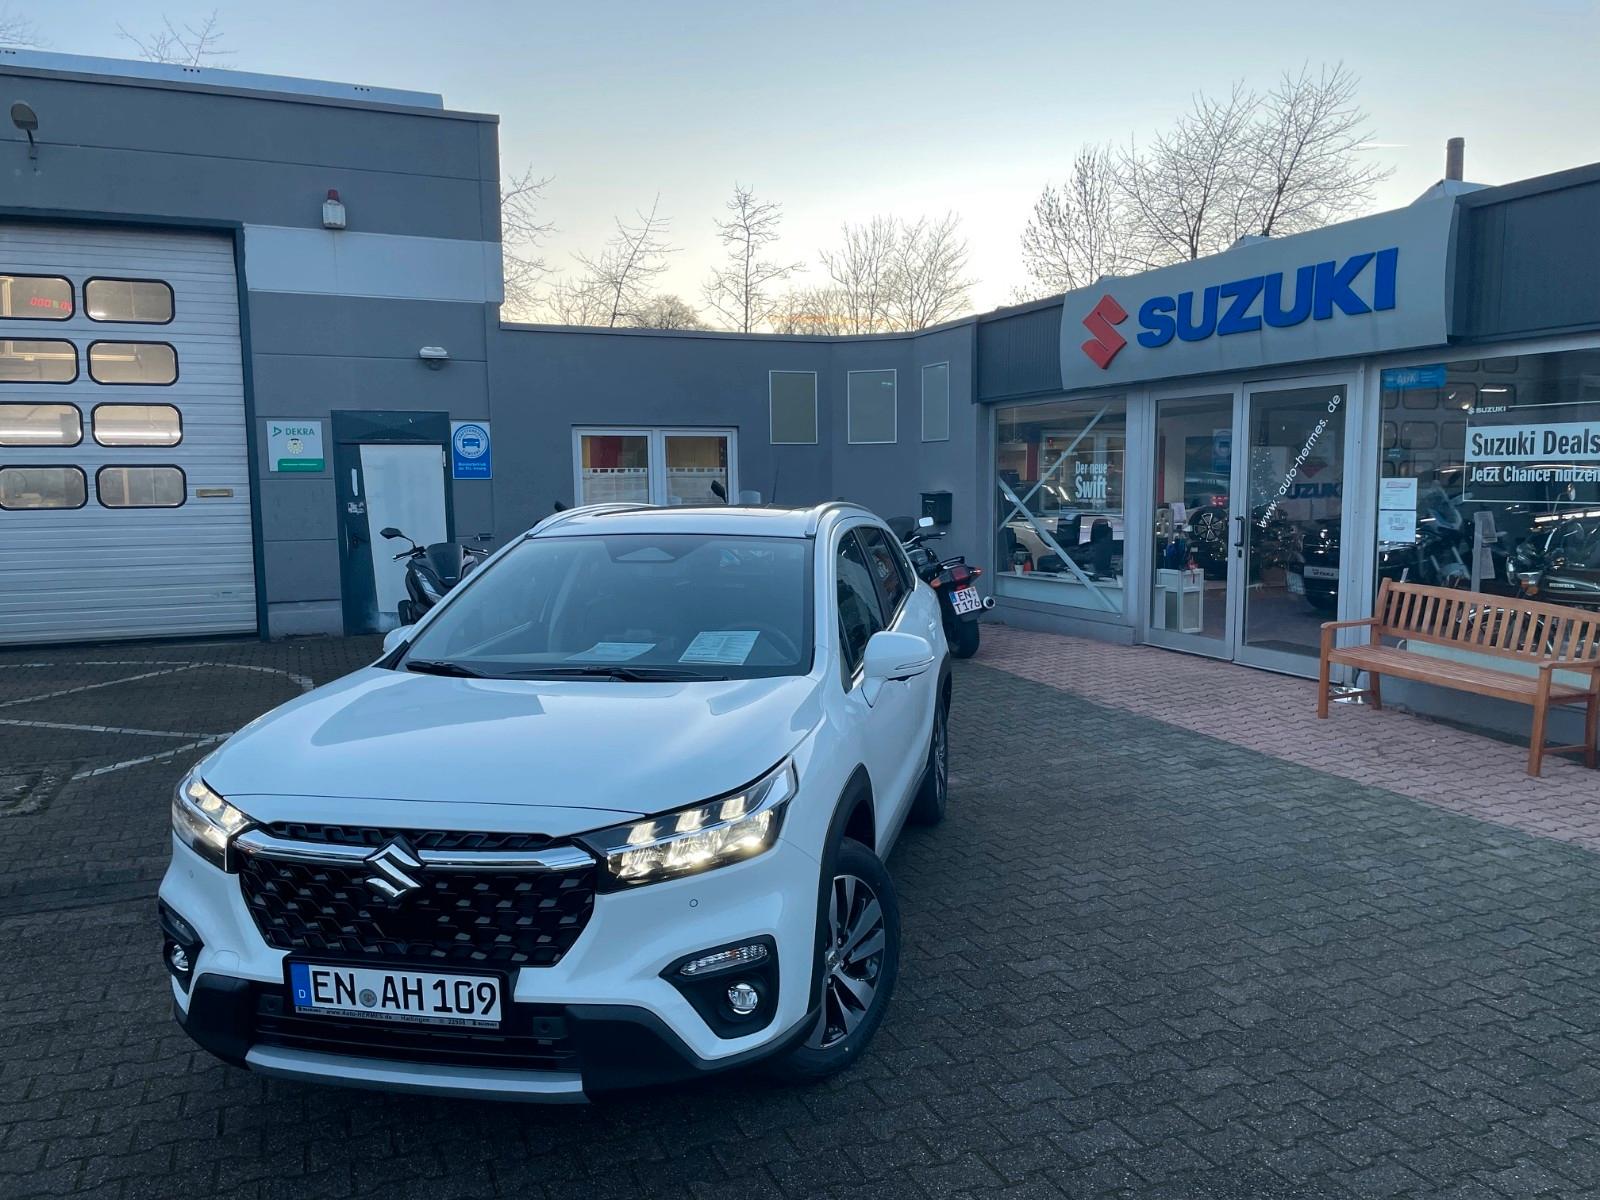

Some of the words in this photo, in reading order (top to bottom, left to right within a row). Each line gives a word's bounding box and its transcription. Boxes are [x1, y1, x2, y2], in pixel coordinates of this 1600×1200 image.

[1137, 247, 1399, 348] SUZUKI
[1475, 406, 1507, 414] SUZUKI
[285, 428, 315, 436] DEKRA
[1471, 431, 1536, 456] Suzuki
[1543, 428, 1600, 455] Deals
[1075, 461, 1088, 474] Der
[1089, 463, 1107, 474] neue
[1470, 466, 1500, 482] Jetzt
[1503, 466, 1551, 482] Chance
[1075, 475, 1107, 499] Swift
[957, 590, 972, 601] EN
[299, 989, 306, 999] D
[312, 970, 356, 1006] EN
[381, 975, 424, 1011] AH
[432, 979, 497, 1015] 109
